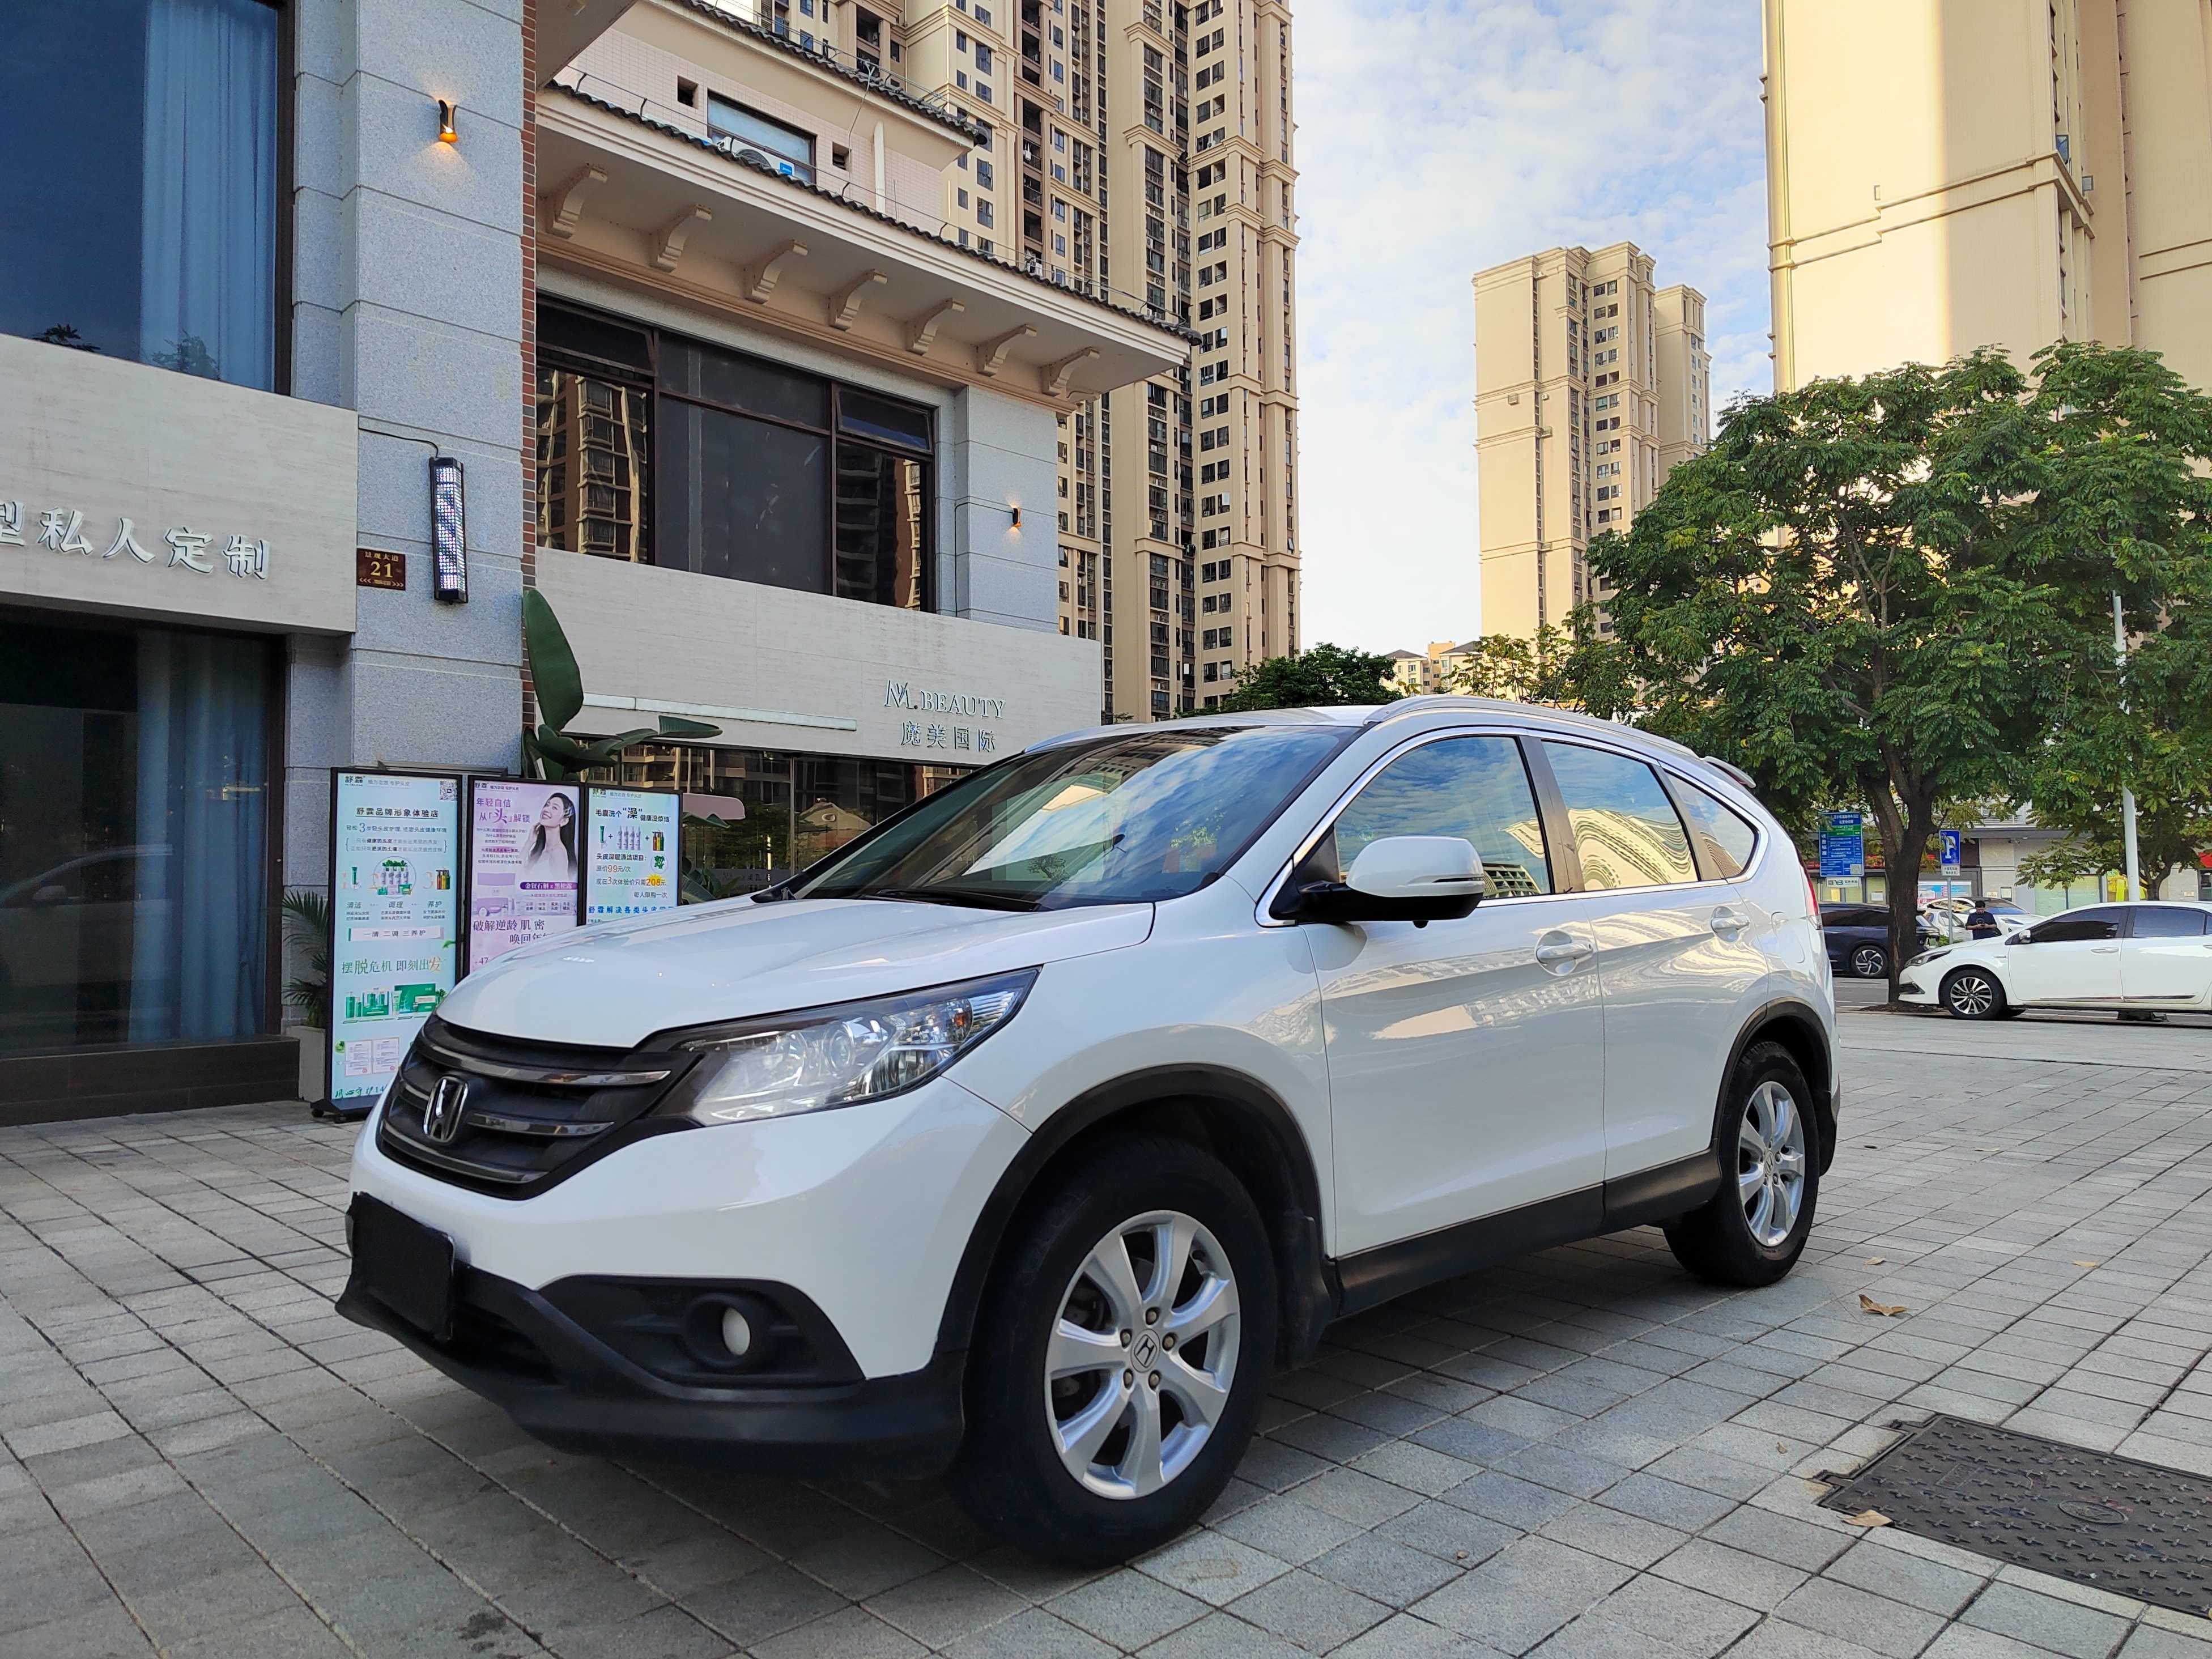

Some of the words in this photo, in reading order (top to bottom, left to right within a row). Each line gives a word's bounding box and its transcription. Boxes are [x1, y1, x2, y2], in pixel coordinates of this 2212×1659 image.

[371, 561, 393, 578] 21
[901, 721, 996, 753] 魔美国际
[477, 797, 512, 807] 年轻自信
[1945, 836, 1956, 859] P
[341, 959, 393, 975] 摆脱危机
[396, 956, 441, 973] 即刻出发
